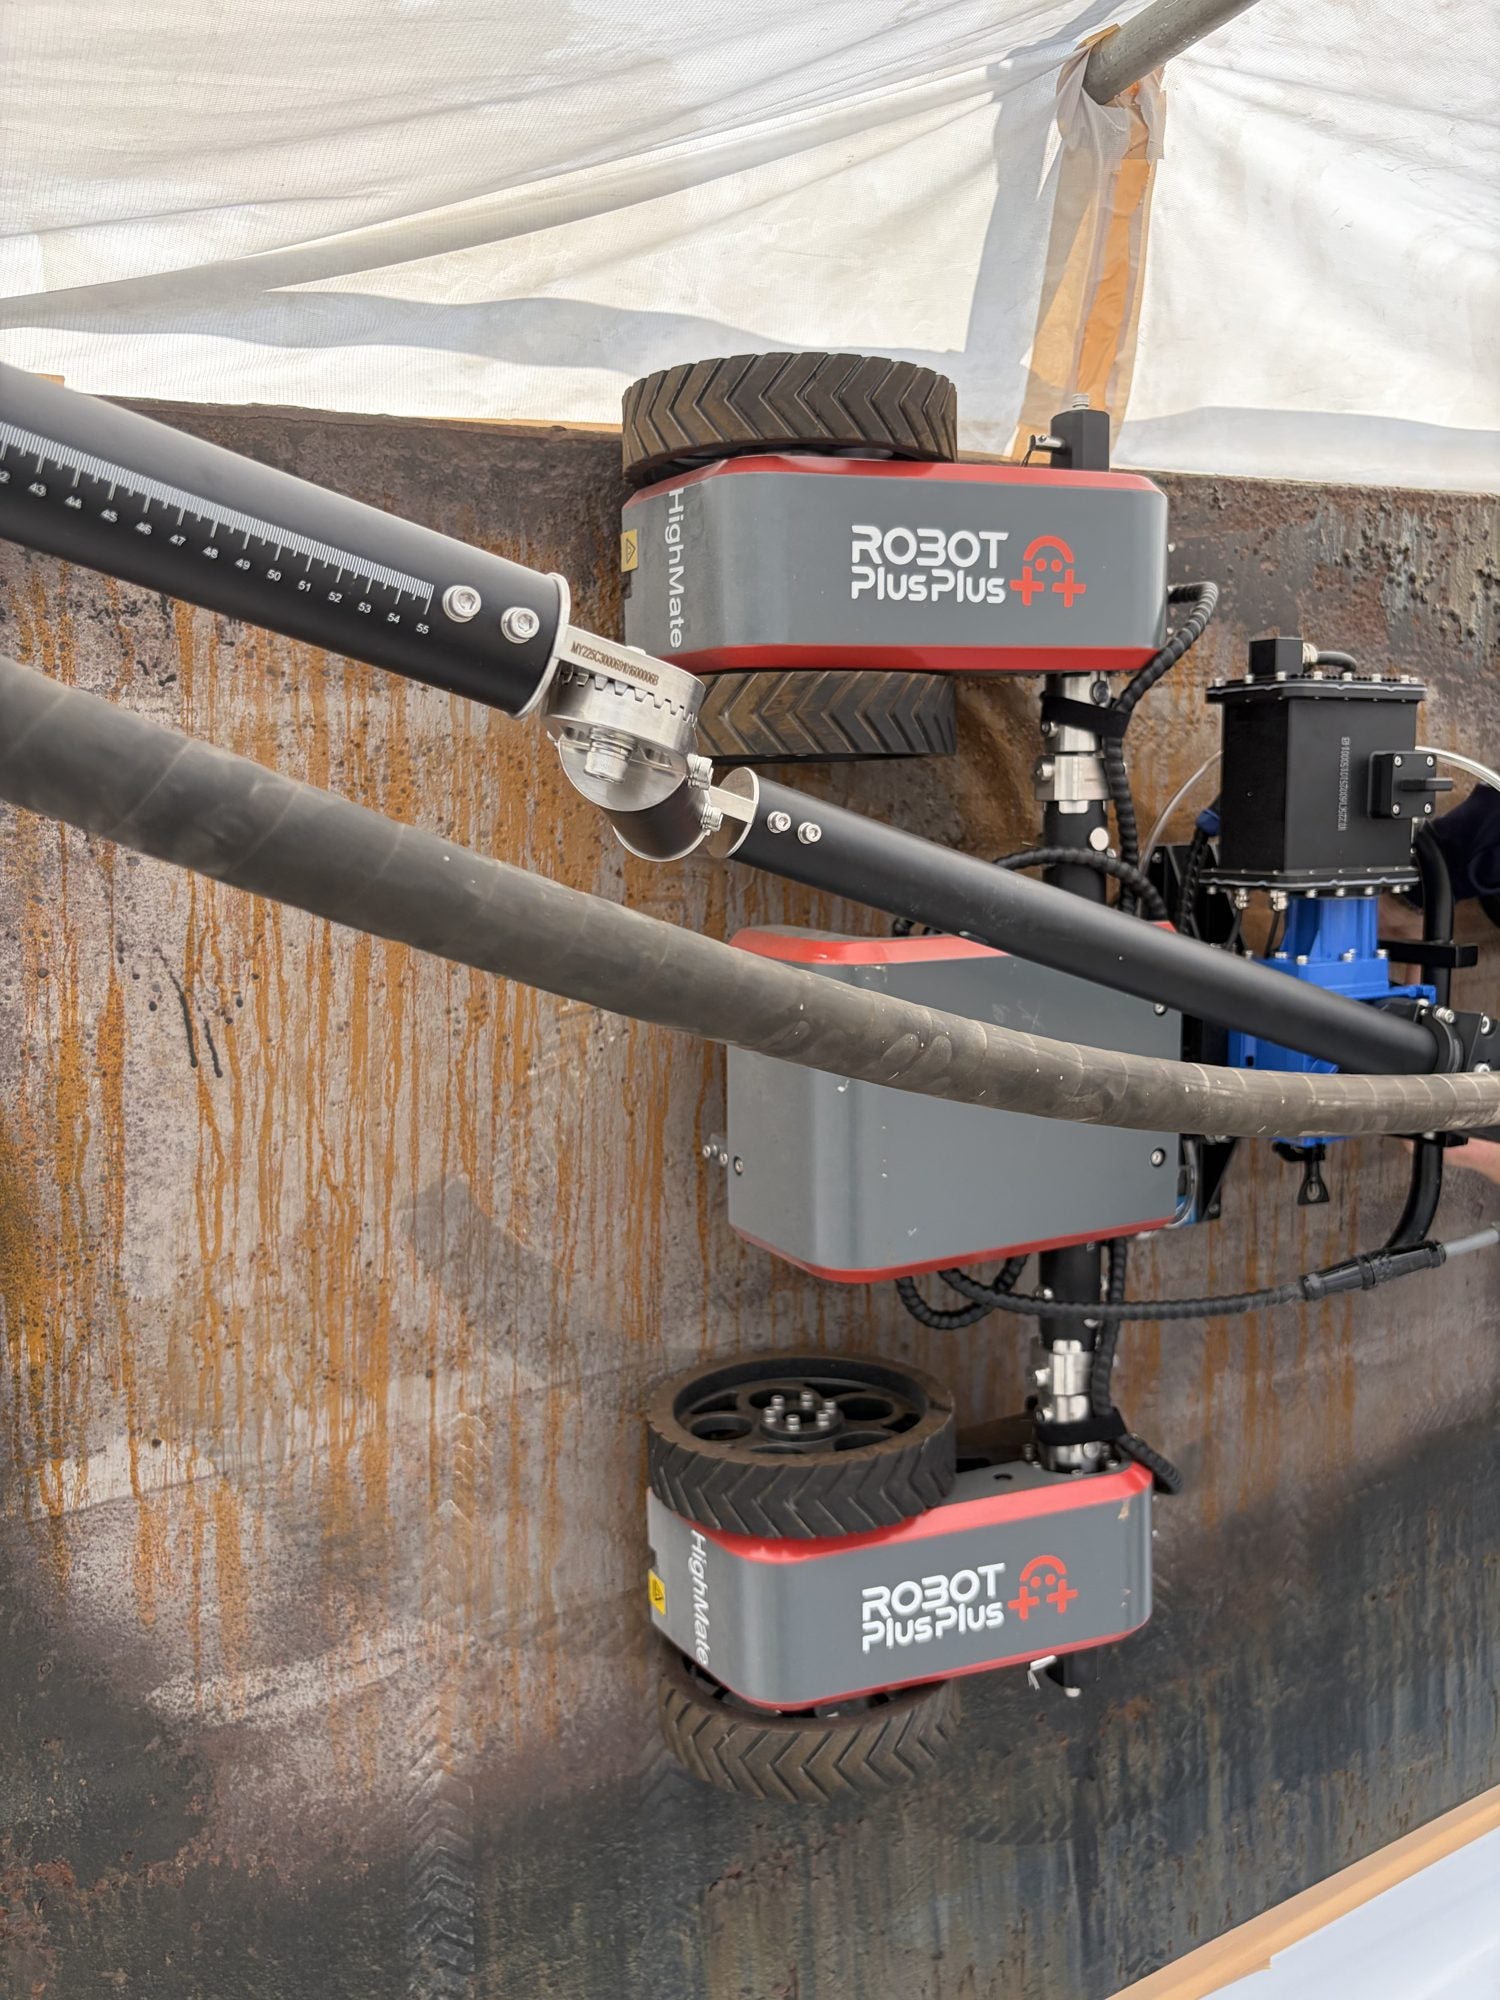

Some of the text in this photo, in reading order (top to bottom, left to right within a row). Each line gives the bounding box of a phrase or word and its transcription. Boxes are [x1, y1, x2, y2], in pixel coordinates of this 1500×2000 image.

[28, 482, 47, 497] 43
[64, 495, 82, 509] 44
[100, 509, 118, 523] 45
[135, 521, 153, 535] 46
[169, 534, 187, 546] 47
[202, 546, 219, 559] 48
[235, 558, 251, 570] 49
[267, 569, 282, 582] 50
[298, 580, 311, 592] 51
[328, 591, 342, 603] 52
[358, 602, 372, 614] 53
[387, 612, 401, 624] 54
[416, 622, 430, 635] 55
[665, 487, 685, 649] HighMate
[851, 525, 1009, 569] ROBOT
[851, 565, 1007, 604] PlusPlus
[688, 1529, 711, 1666] HighMate
[862, 1562, 1006, 1621] ROBOT
[862, 1601, 1005, 1655] PlusPlus
